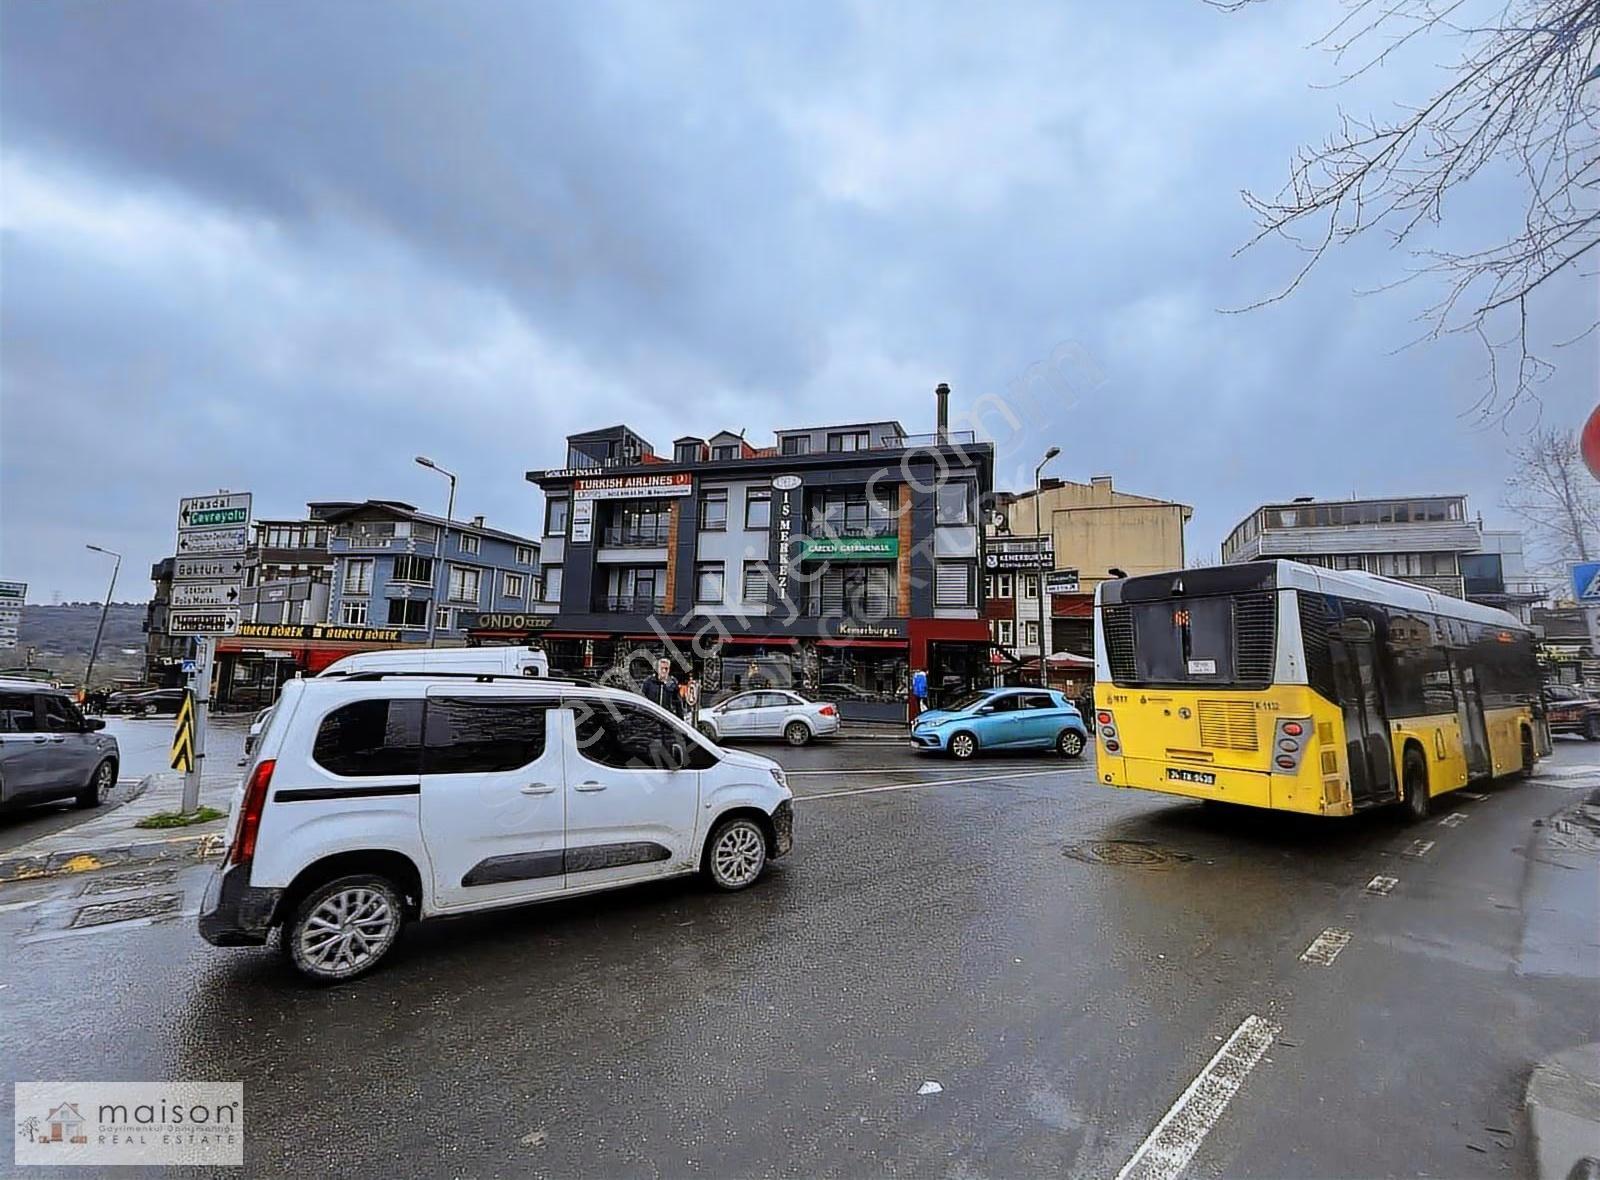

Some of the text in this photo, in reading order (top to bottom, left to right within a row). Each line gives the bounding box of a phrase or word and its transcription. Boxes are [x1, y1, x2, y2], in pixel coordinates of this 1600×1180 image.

[580, 475, 673, 489] TURKISH AIRLINES
[191, 498, 230, 509] Hasdal
[191, 509, 246, 524] Çevreyolu
